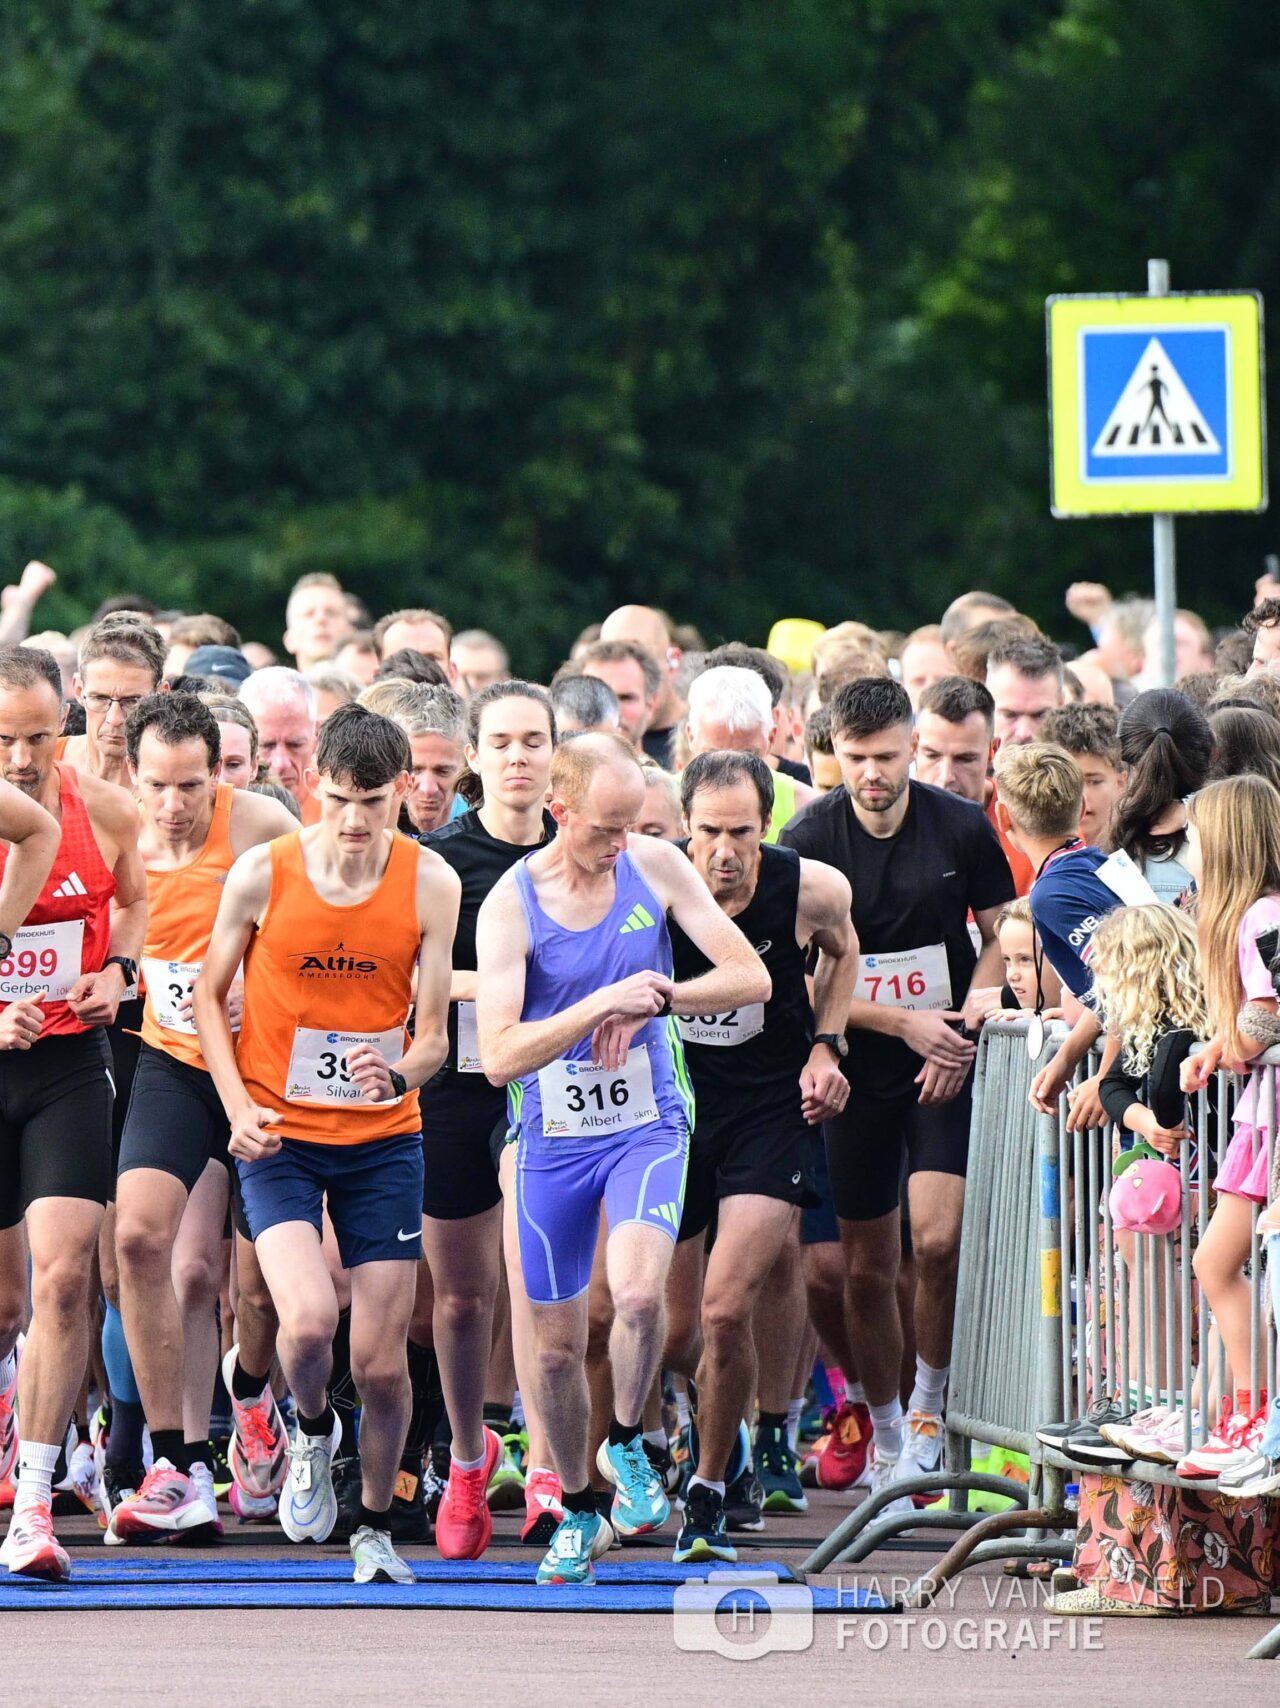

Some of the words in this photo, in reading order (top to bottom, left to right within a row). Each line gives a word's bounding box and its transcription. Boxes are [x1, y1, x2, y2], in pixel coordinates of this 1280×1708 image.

[1068, 915, 1098, 946] QNB
[299, 956, 378, 973] Altis
[298, 972, 376, 980] AMERSFOORT
[0, 981, 50, 994] Gerben
[864, 971, 926, 1001] 716
[688, 1026, 730, 1039] Sjoerd
[565, 1078, 629, 1112] 316
[581, 1113, 622, 1128] Albert
[634, 1108, 653, 1120] 5km
